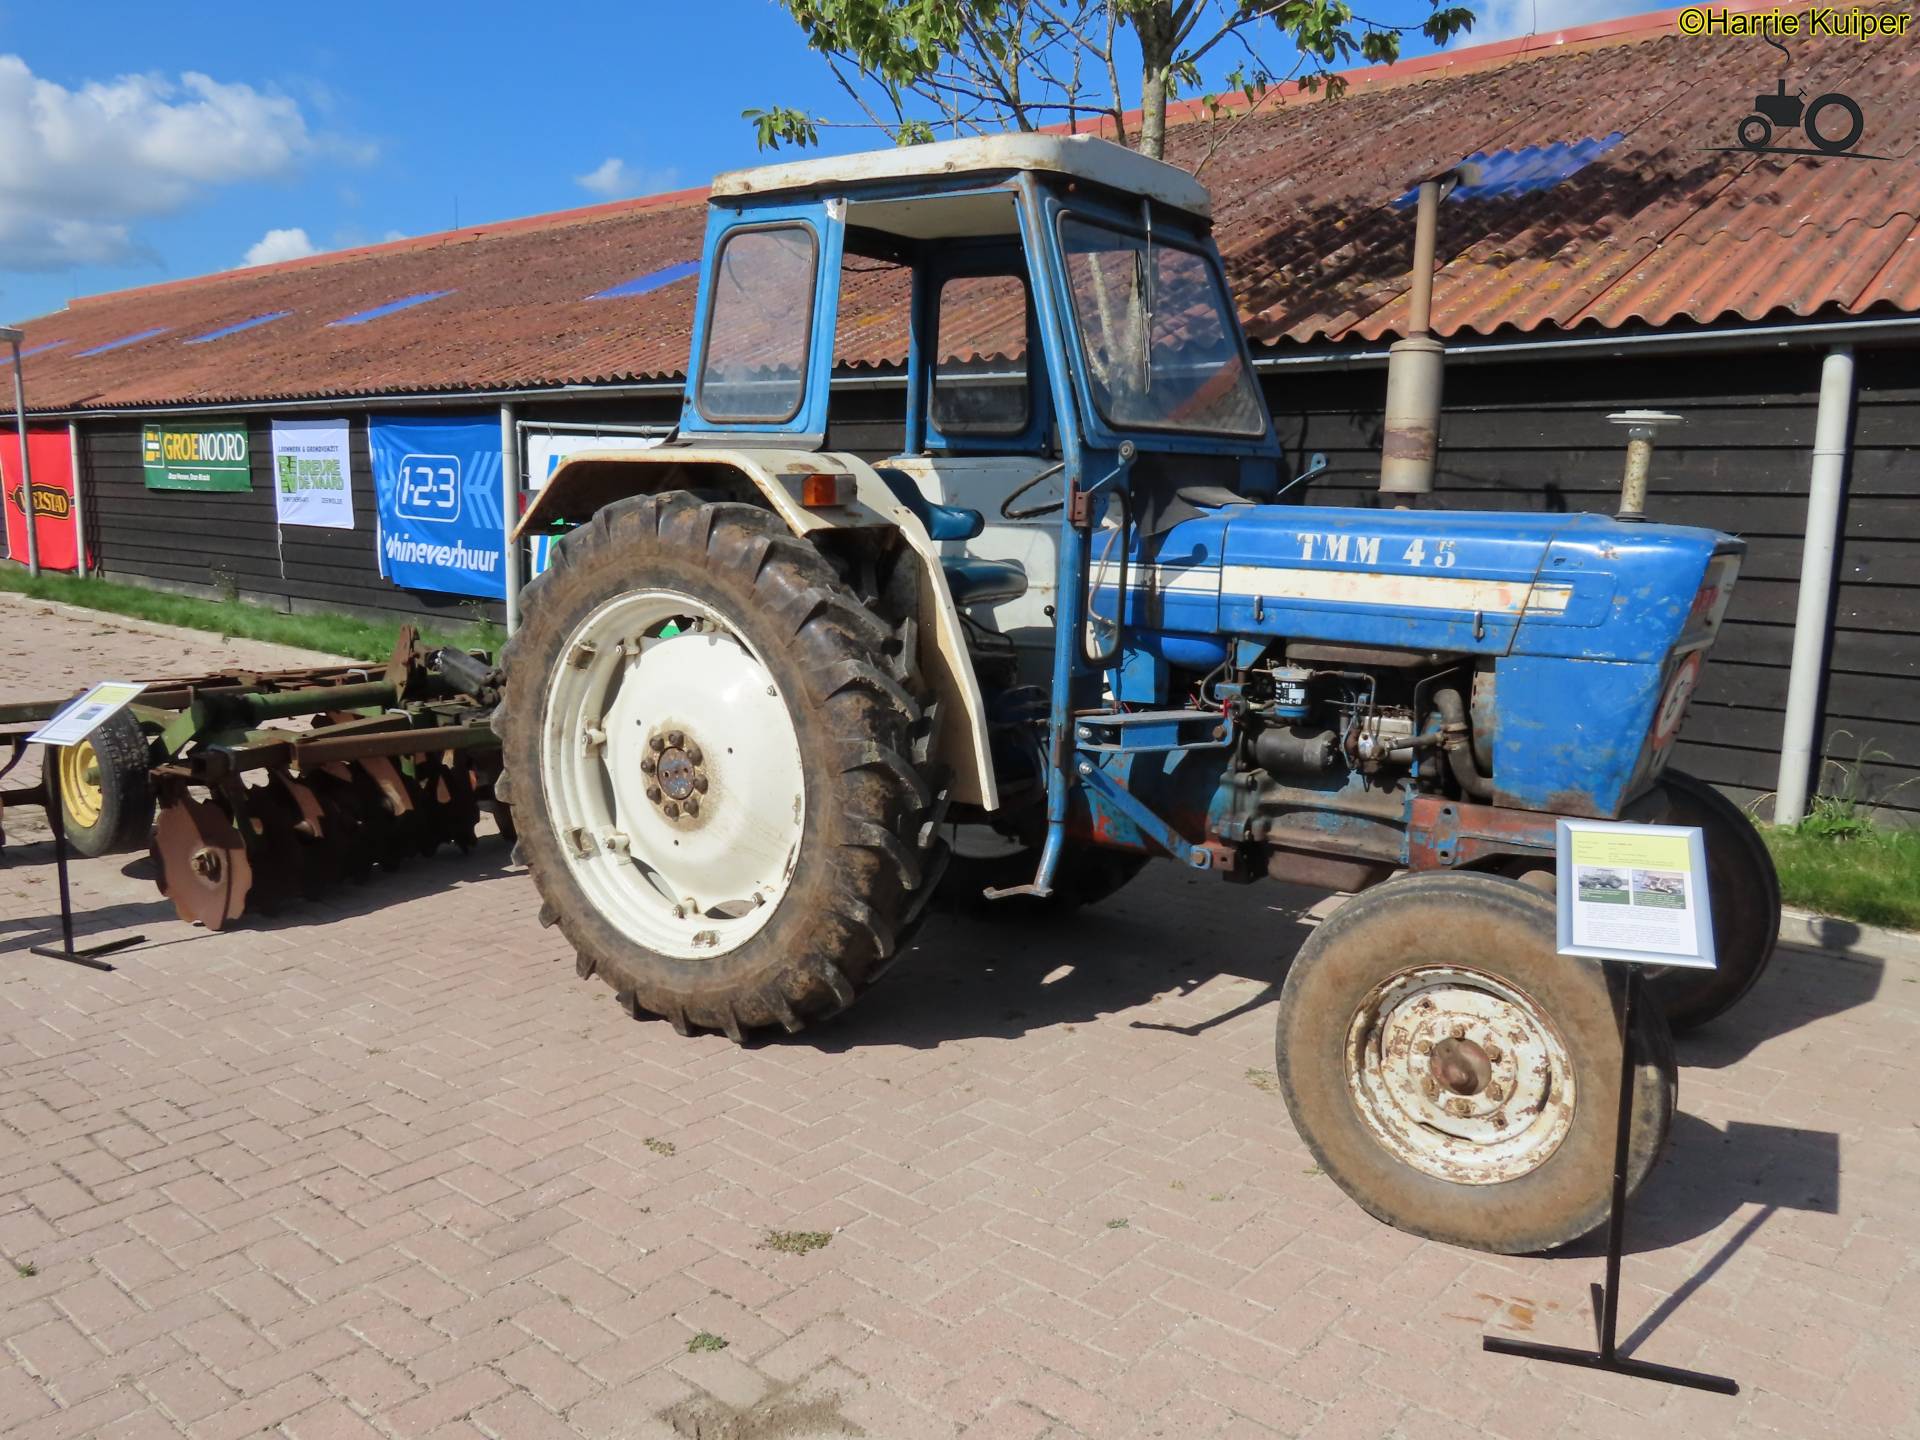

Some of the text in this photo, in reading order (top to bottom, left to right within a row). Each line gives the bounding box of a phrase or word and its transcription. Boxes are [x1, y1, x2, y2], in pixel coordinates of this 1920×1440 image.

[163, 432, 246, 461] GROENOORD
[1296, 533, 1457, 568] TMM 45
